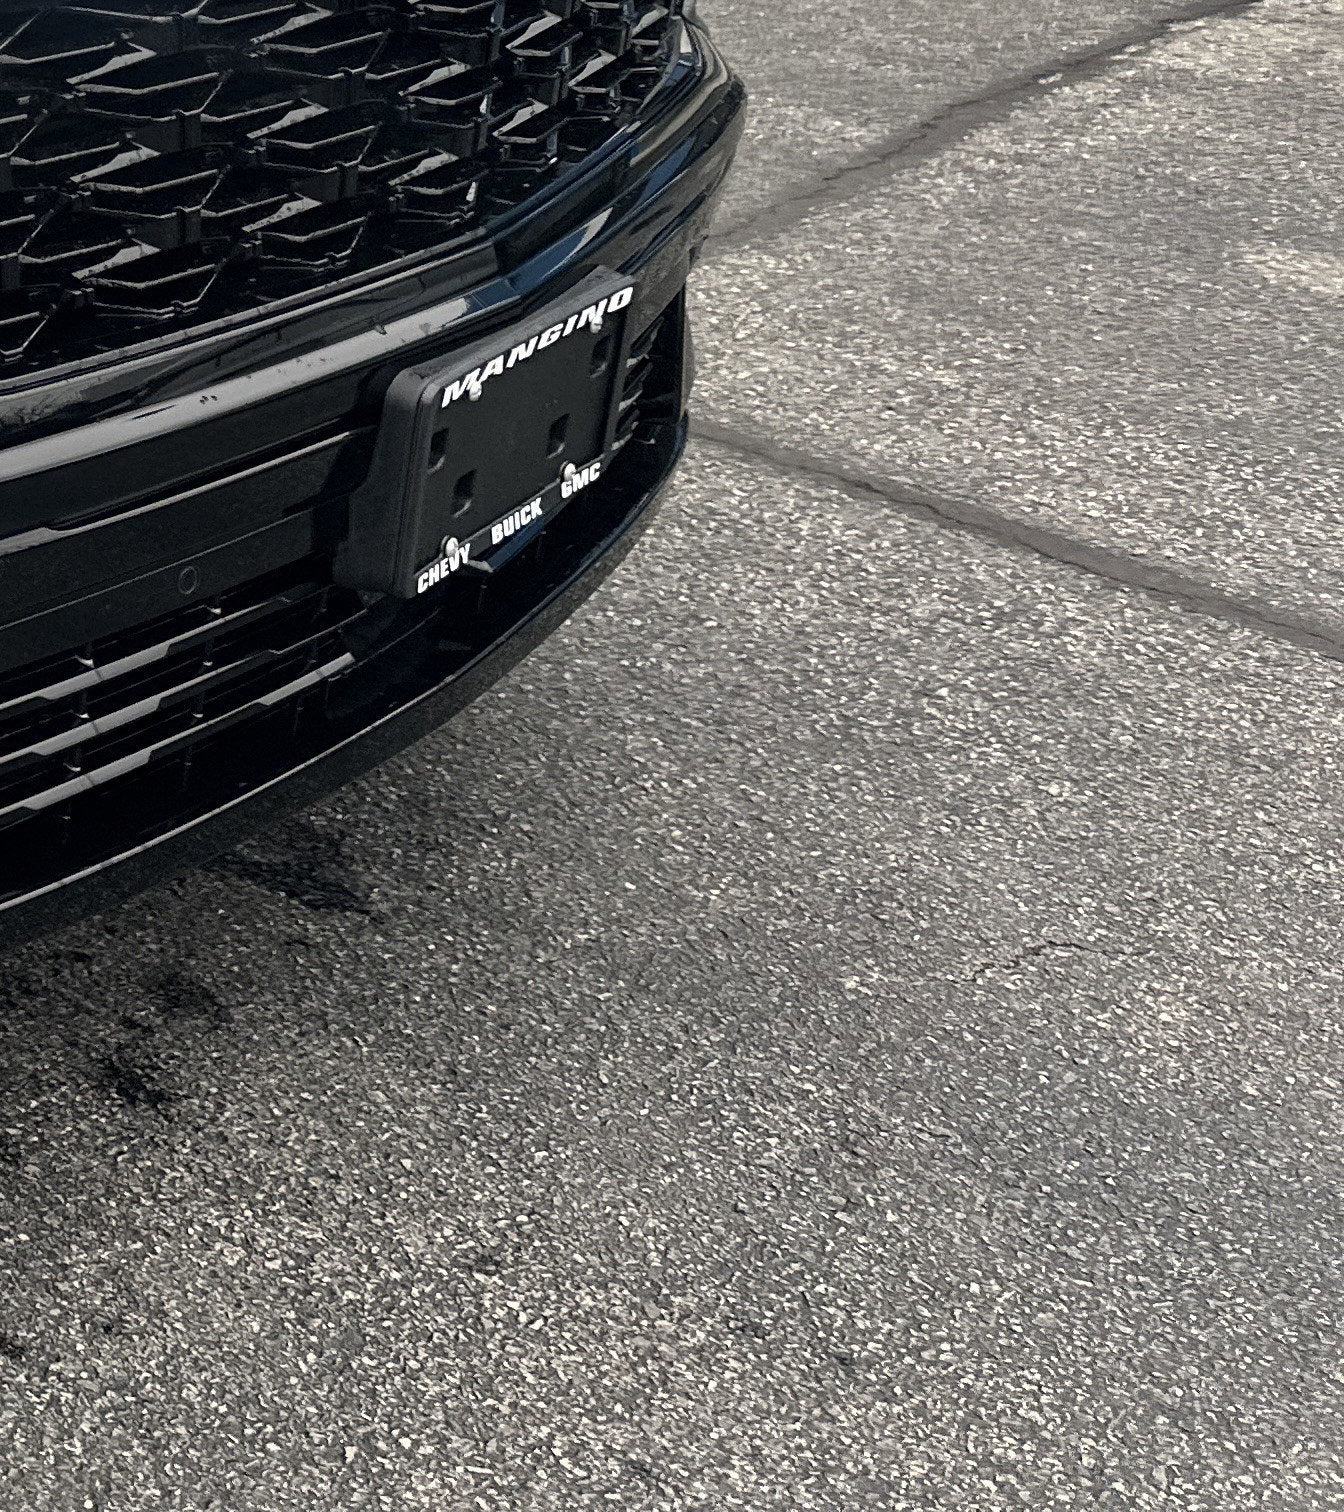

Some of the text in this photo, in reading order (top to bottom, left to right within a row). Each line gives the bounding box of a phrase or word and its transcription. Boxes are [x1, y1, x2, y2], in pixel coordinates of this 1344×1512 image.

[440, 285, 635, 409] MANGINO
[416, 462, 602, 594] CHEVY BUICK GMC
